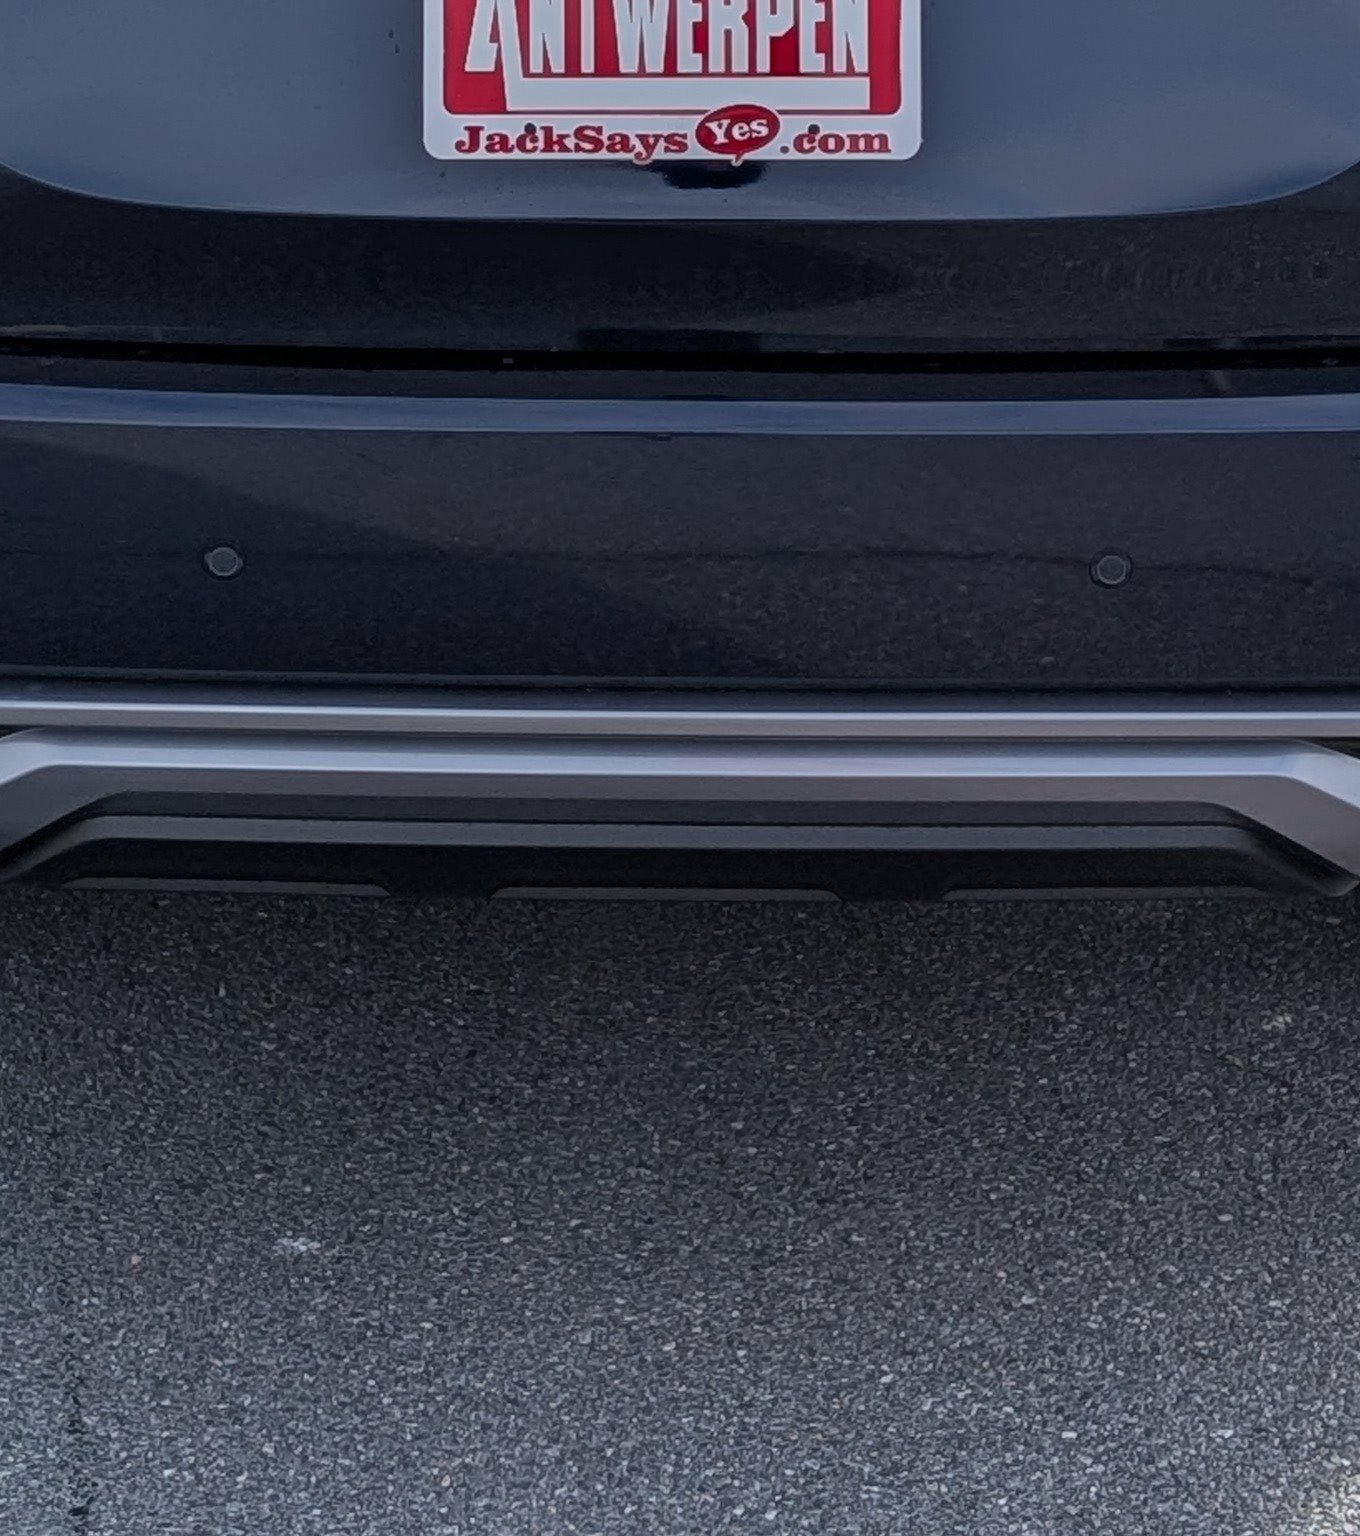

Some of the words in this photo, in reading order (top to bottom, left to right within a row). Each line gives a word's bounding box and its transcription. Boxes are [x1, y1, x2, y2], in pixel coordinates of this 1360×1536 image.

[454, 123, 689, 160] JackSays
[704, 117, 770, 146] Yes
[779, 127, 892, 155] .com
